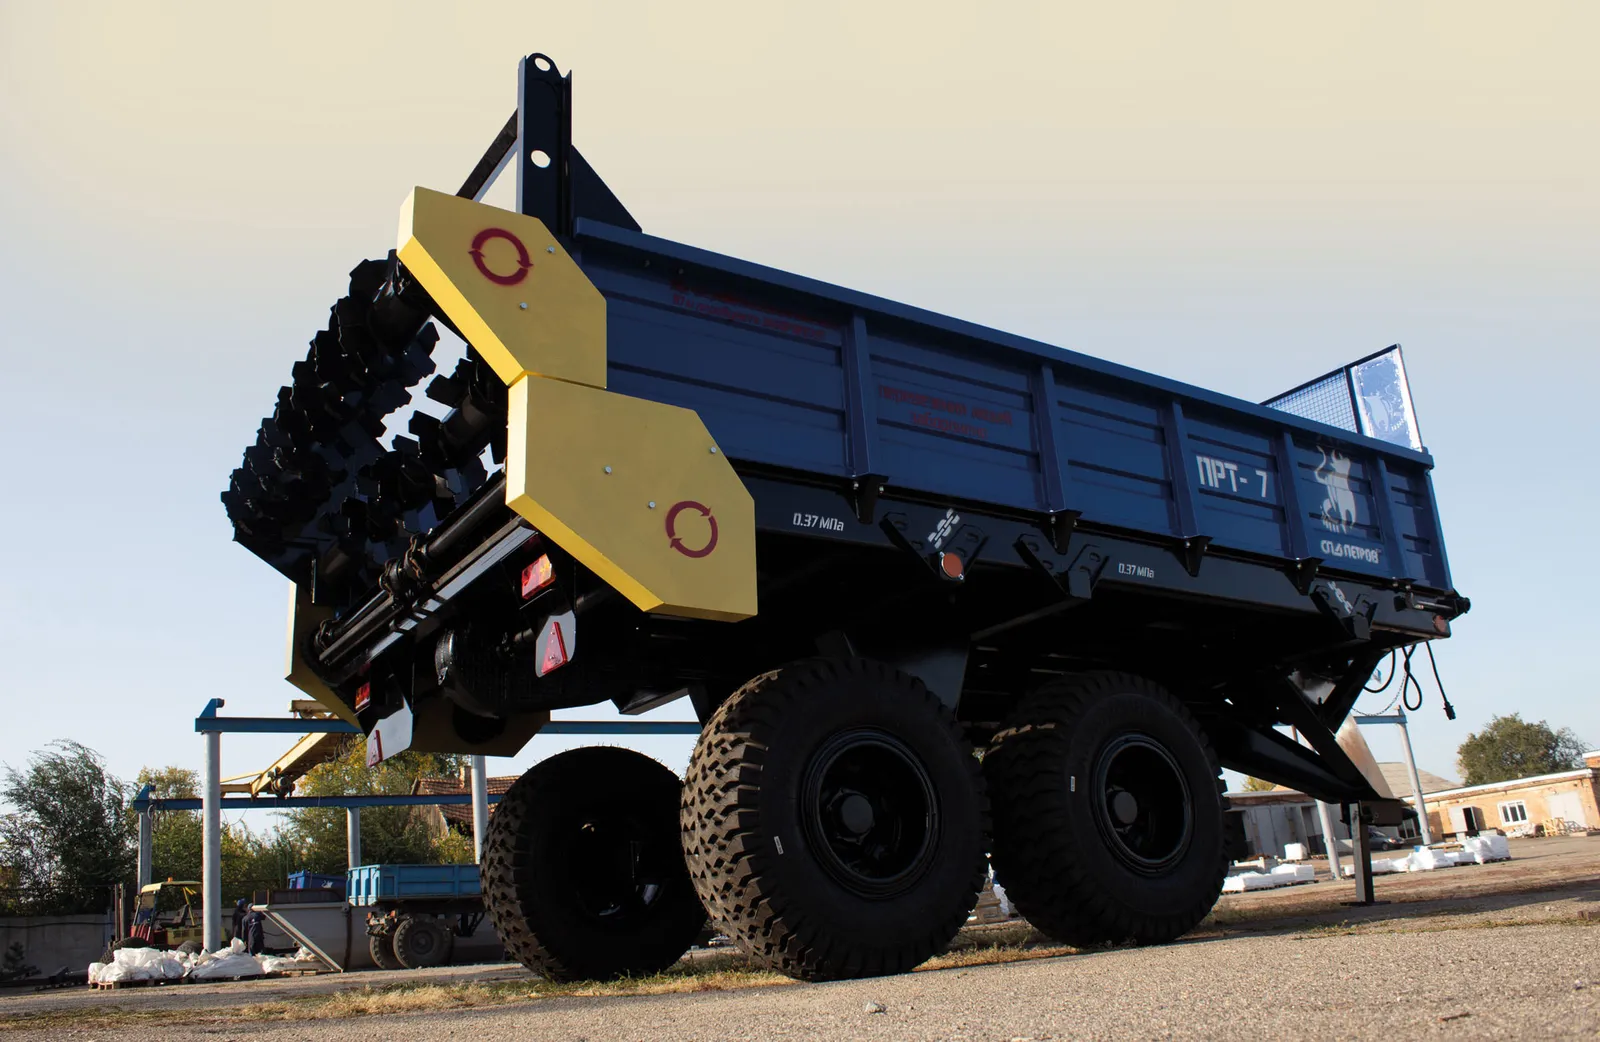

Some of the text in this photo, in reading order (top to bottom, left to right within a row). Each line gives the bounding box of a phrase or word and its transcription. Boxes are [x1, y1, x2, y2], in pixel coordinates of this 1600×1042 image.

[792, 512, 845, 532] 0.37 МПа
[1343, 543, 1379, 564] ПЕТРОВ
[1118, 562, 1136, 576] 0.37
